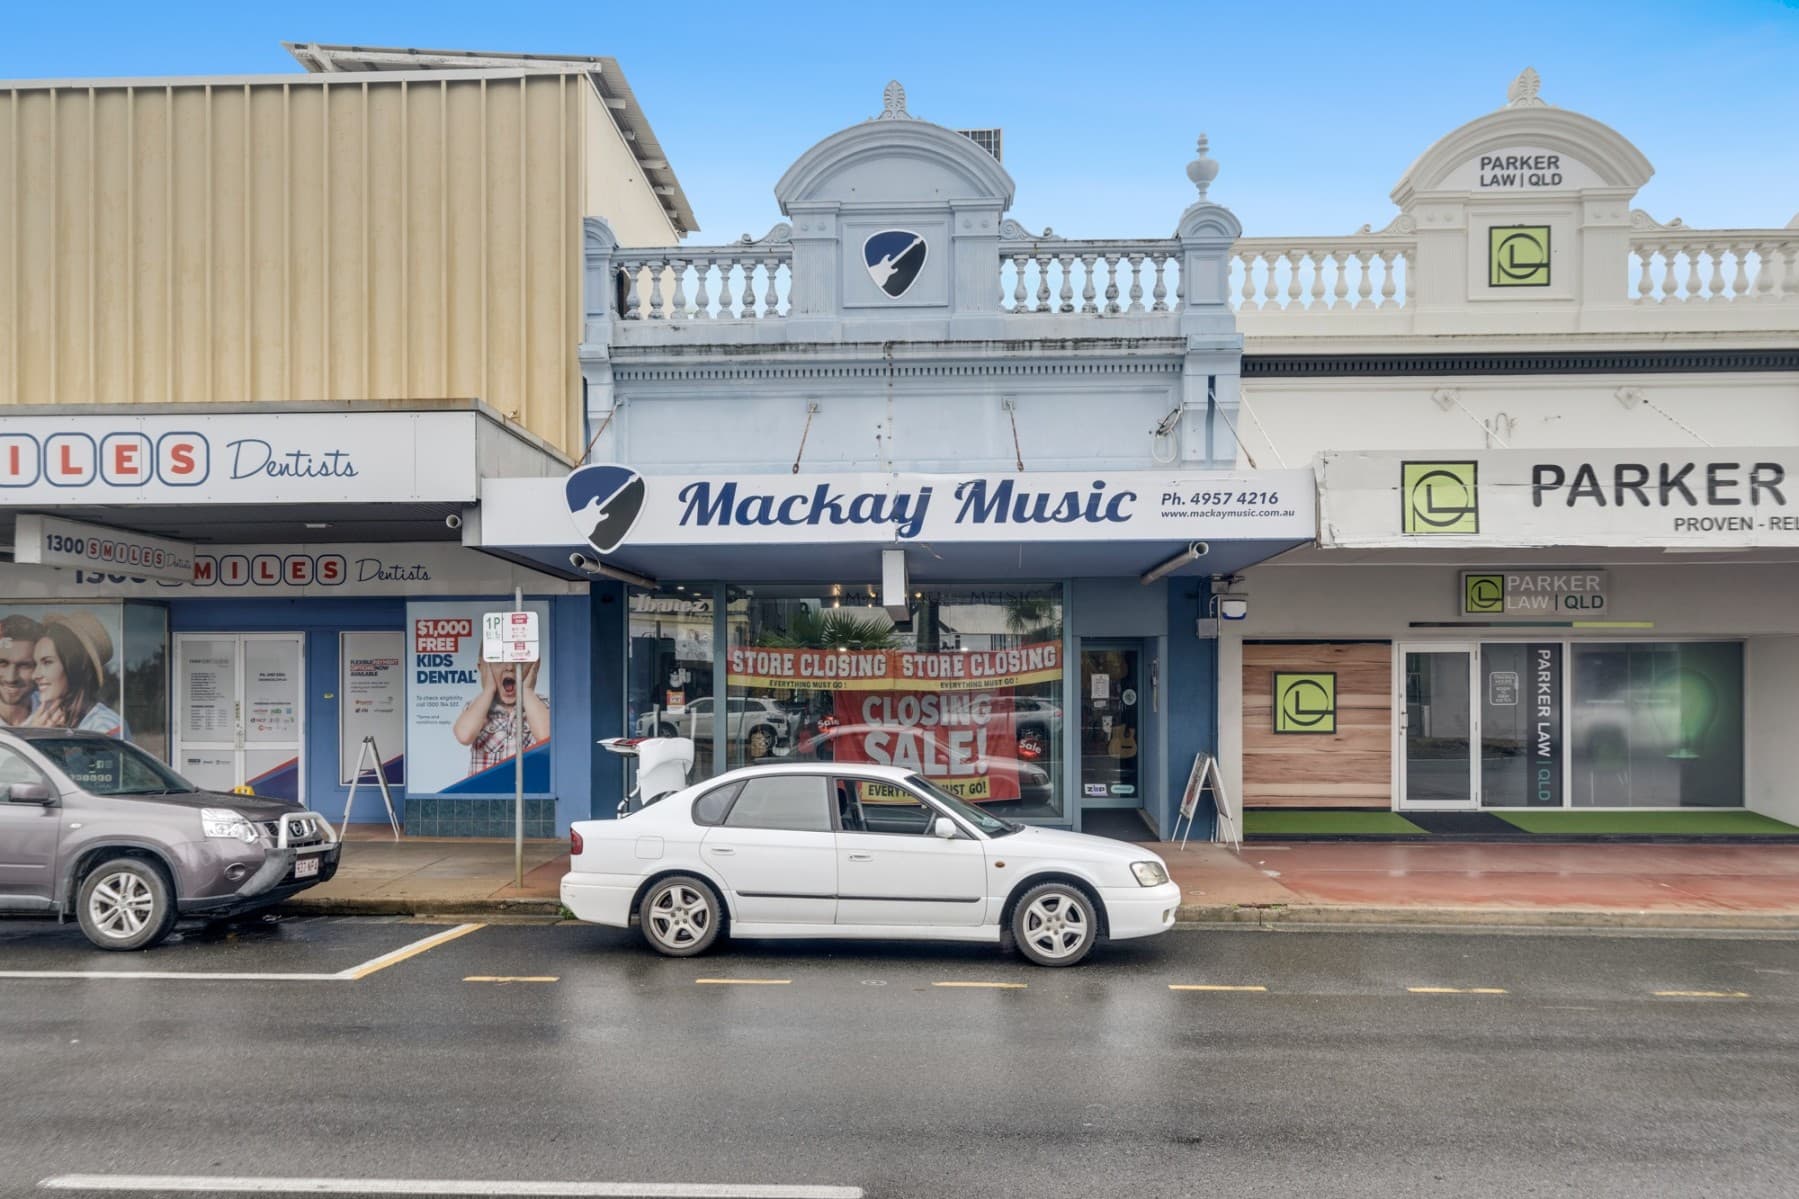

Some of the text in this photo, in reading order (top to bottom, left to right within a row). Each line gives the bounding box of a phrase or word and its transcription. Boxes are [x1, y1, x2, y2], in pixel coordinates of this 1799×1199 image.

[1480, 156, 1560, 170] PARKER
[1480, 174, 1516, 187] LAW
[1528, 173, 1563, 187] QLD
[226, 438, 359, 480] Dentists
[1532, 461, 1788, 508] PARKER
[1161, 491, 1279, 506] Ph. 4957 4216
[678, 479, 1137, 539] Mackay Music
[1161, 508, 1296, 519] www.mackaymusic.com.au
[1674, 516, 1754, 531] PROVEN
[46, 534, 84, 556] 1300
[194, 558, 431, 582] MILES Dentists
[1507, 575, 1600, 591] PARKER
[1507, 596, 1549, 609] LAW
[1564, 595, 1604, 609] QLD
[418, 621, 470, 636] $1,000
[418, 638, 455, 651] FREE
[416, 654, 453, 667] KIDS
[733, 645, 1057, 678] STORE CLOSING STORE CLOSING
[769, 680, 811, 689] EVERYTHING
[812, 681, 832, 689] MUST
[940, 681, 983, 689] EVERYTHING
[983, 679, 1002, 687] MUST
[1537, 649, 1552, 718] PARKER
[862, 693, 993, 728] CLOSING
[1019, 738, 1042, 754] Sale
[1537, 721, 1552, 757] LAW
[864, 727, 988, 777] SALE!
[969, 781, 987, 794] GO!
[1537, 768, 1552, 801] QLD
